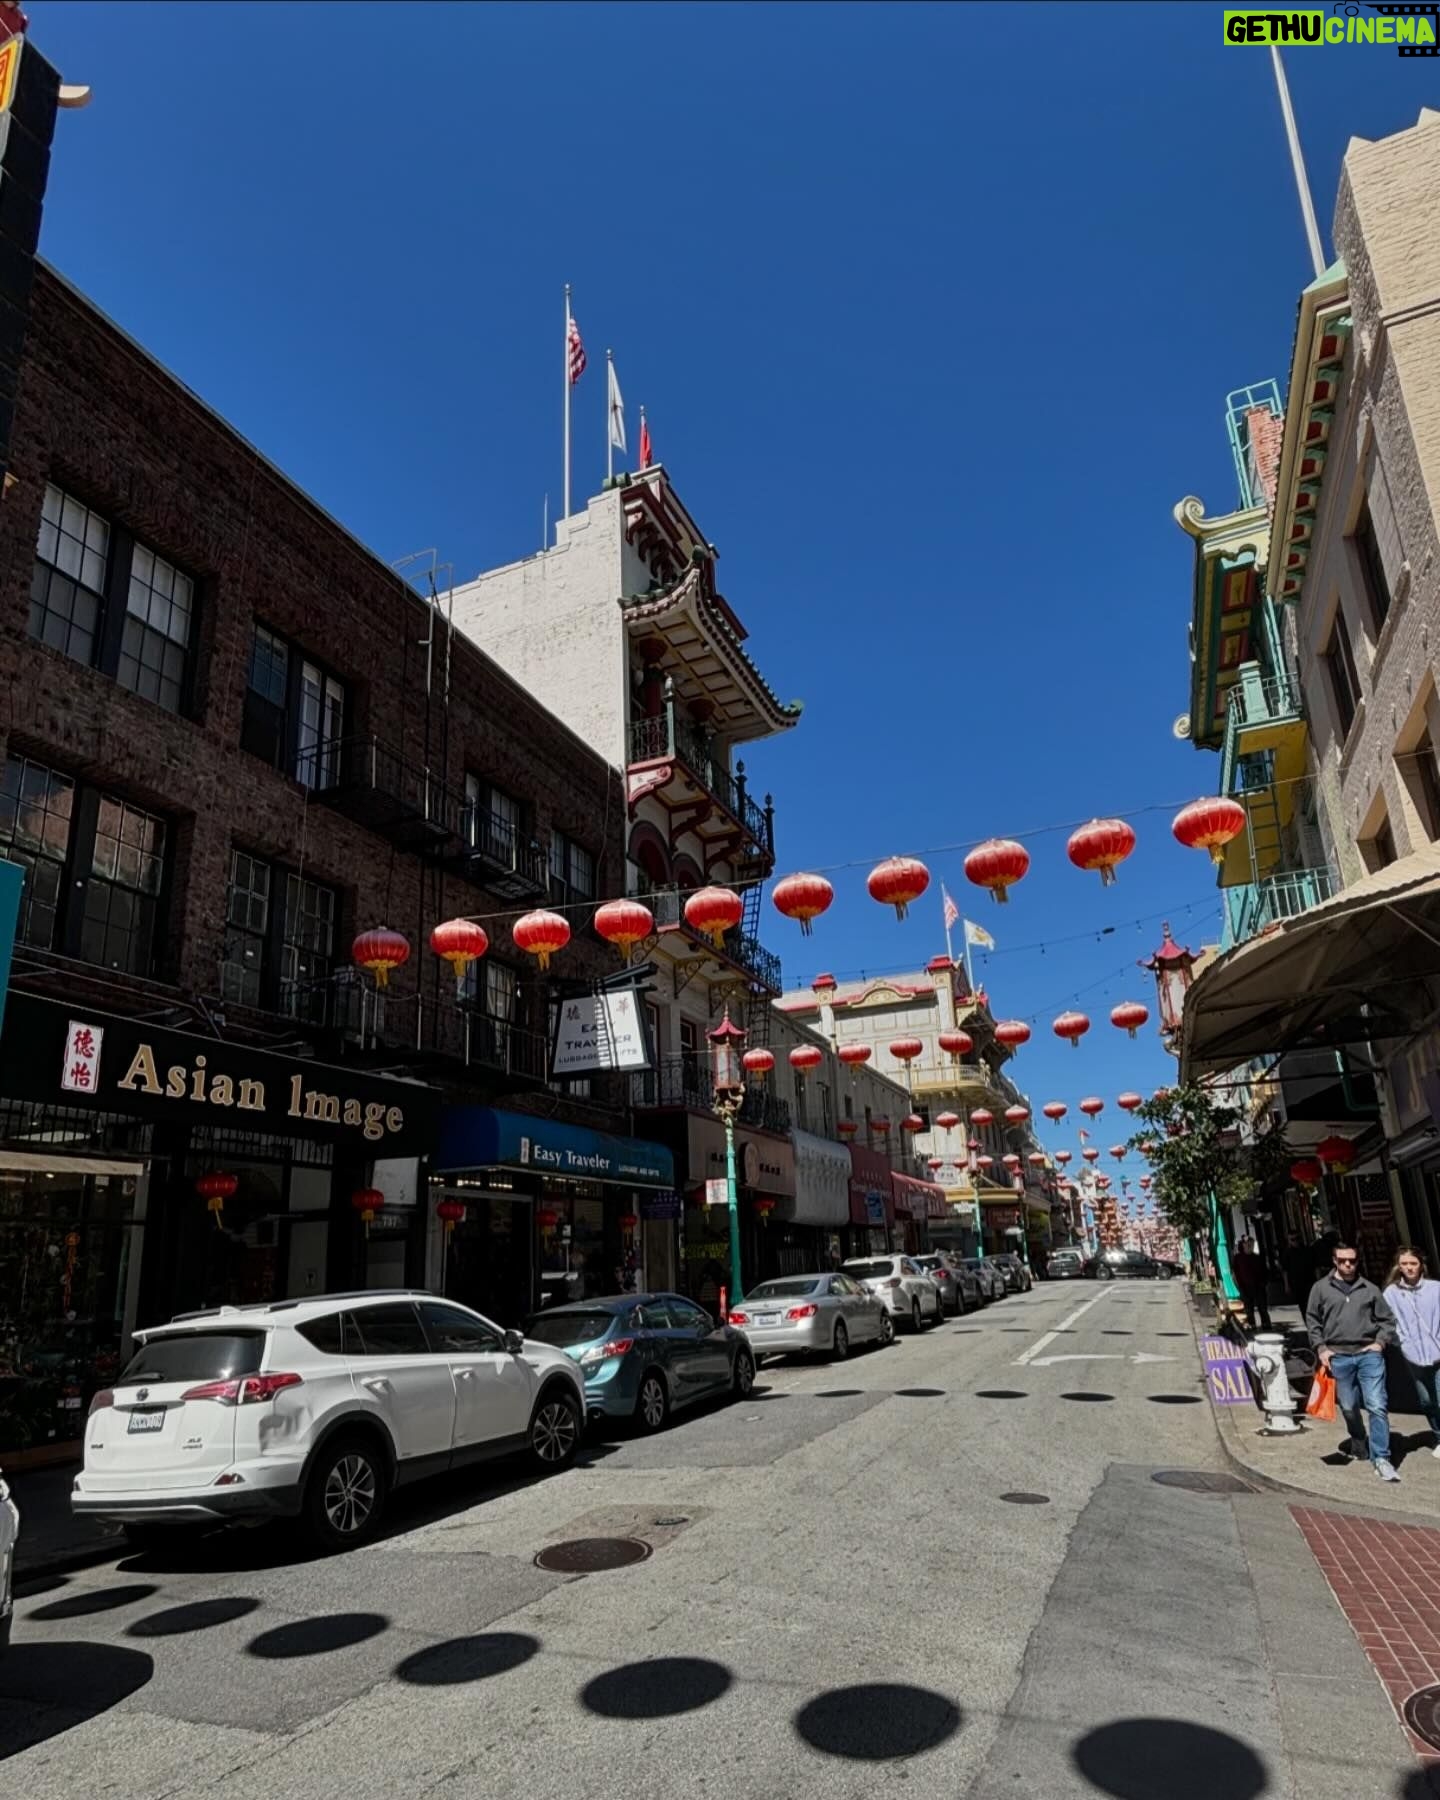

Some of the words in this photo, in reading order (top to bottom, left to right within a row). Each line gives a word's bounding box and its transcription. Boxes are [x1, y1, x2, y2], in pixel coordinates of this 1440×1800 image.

[117, 1044, 266, 1111] Asian
[287, 1074, 404, 1141] Image
[534, 1145, 562, 1167] Easy
[565, 1149, 611, 1170] Traveler
